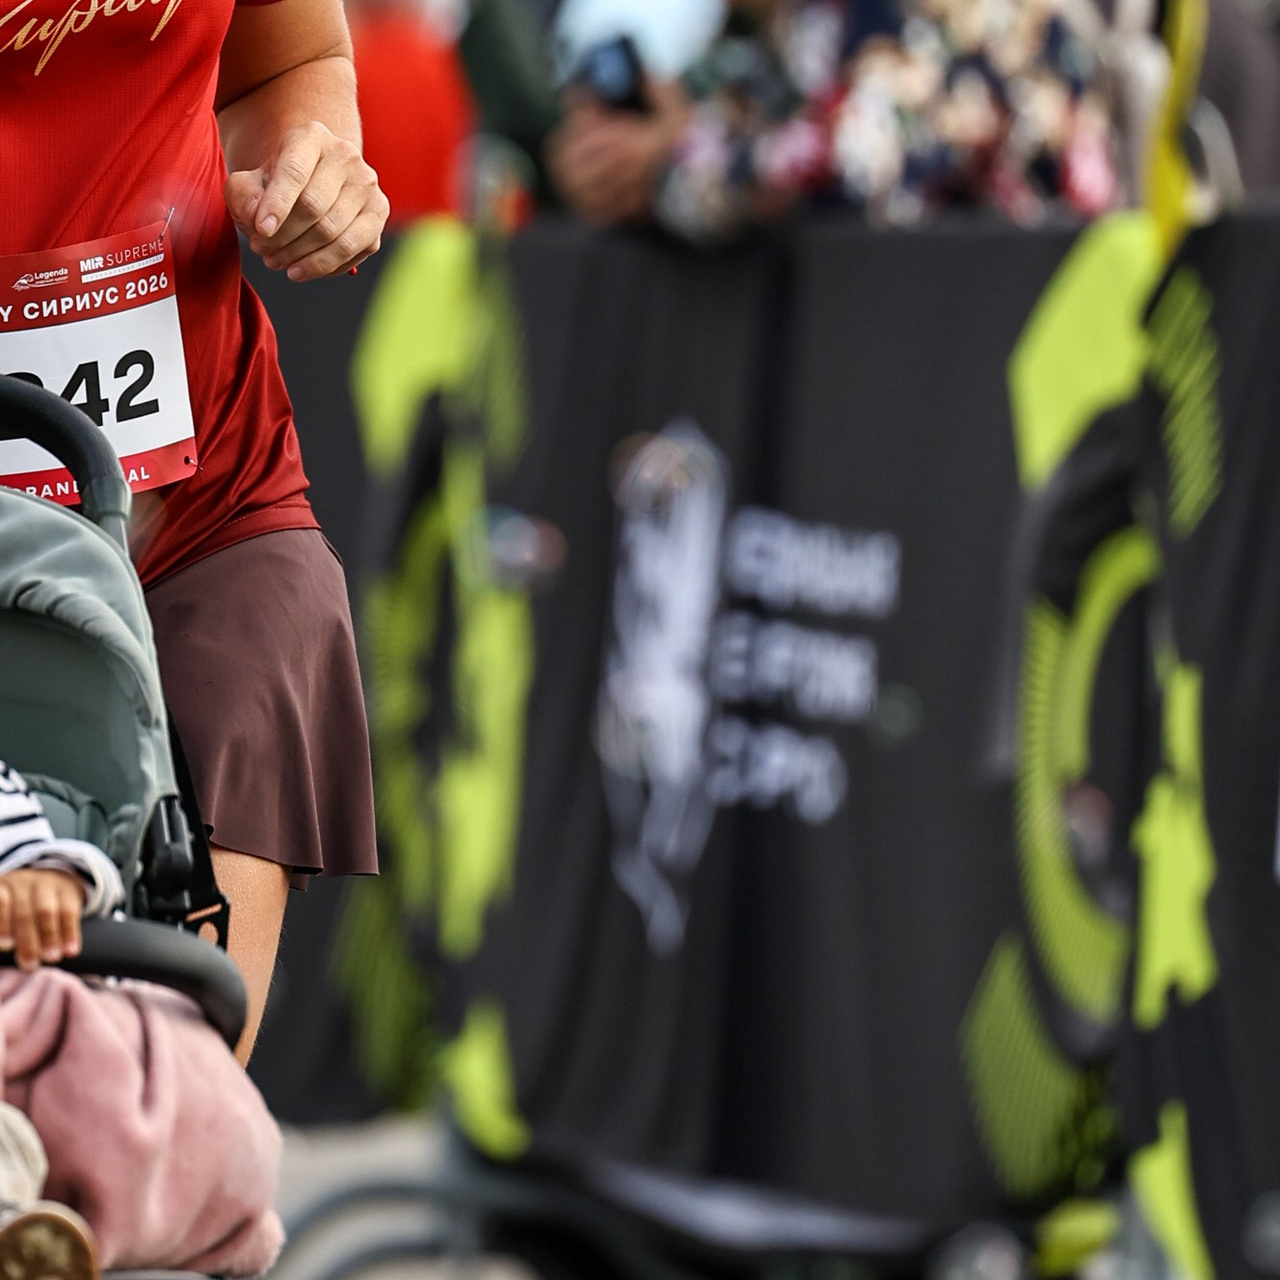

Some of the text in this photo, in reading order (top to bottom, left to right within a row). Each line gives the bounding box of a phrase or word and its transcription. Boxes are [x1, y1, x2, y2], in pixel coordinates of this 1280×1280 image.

[80, 239, 164, 272] MIR SUPREME
[34, 267, 69, 280] Legenda
[22, 287, 120, 320] СИРИУС
[125, 271, 169, 301] 2026
